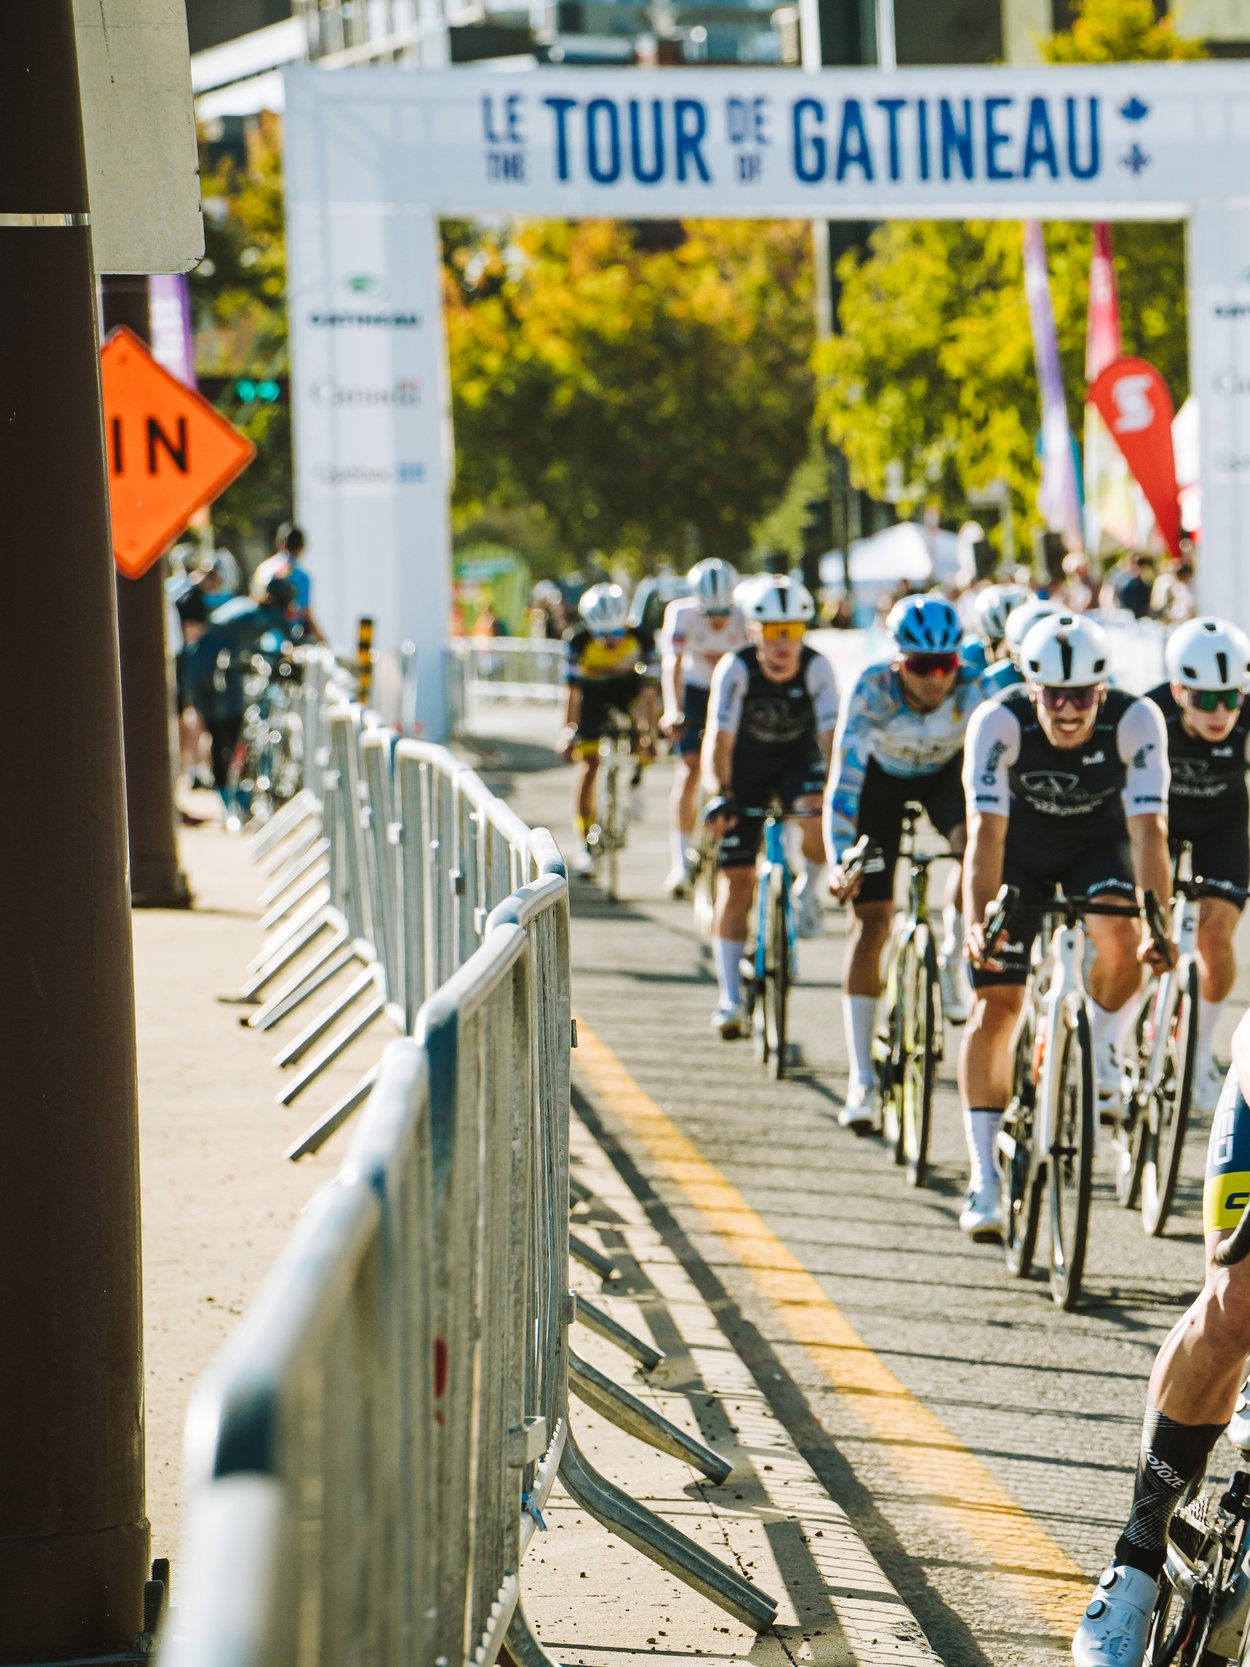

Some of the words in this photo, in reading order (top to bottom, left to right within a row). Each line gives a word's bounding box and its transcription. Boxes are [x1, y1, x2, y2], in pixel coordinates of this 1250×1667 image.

[482, 96, 521, 142] LE
[544, 98, 711, 184] TOUR
[727, 96, 769, 143] DE
[793, 97, 1101, 182] GATINEAU
[486, 153, 525, 184] THE
